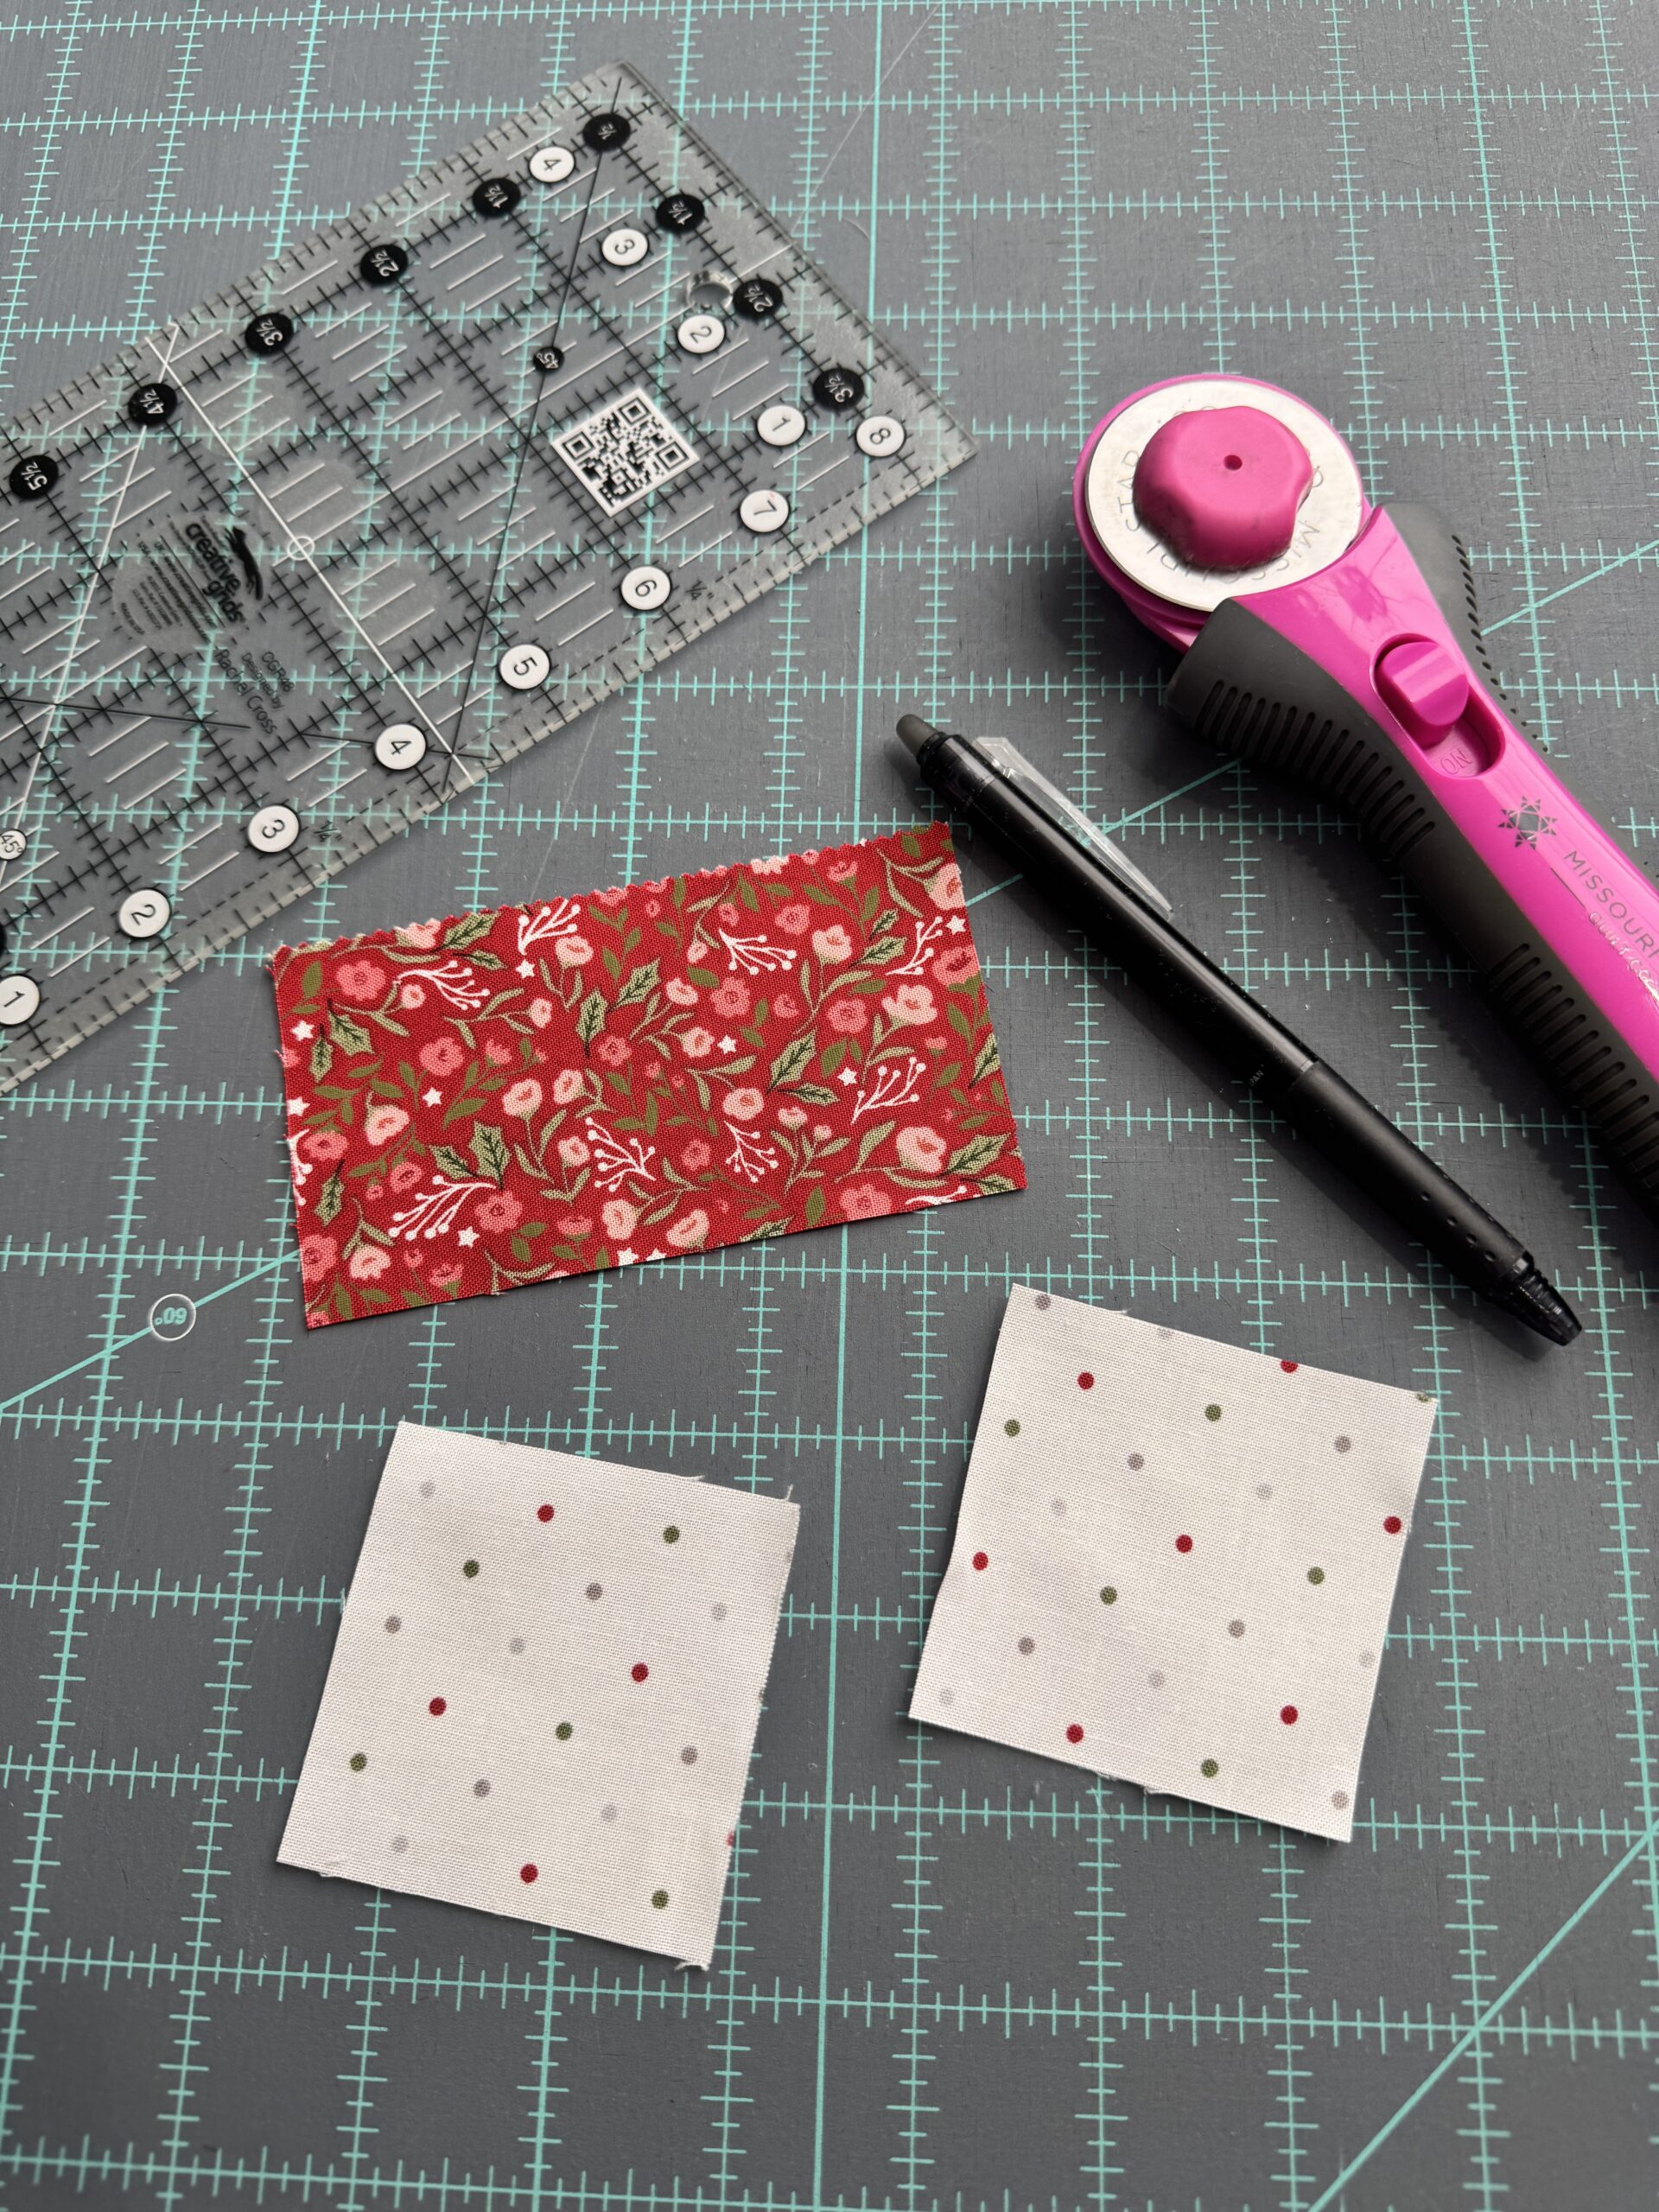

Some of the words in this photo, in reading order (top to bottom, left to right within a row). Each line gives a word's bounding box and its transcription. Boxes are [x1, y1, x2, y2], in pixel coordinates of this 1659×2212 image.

[543, 159, 562, 170] 4
[613, 238, 636, 255] 3
[689, 326, 713, 344] 2
[772, 416, 791, 432] 1
[869, 428, 892, 445] 8
[753, 499, 778, 516] 7
[187, 524, 240, 596] creative
[634, 579, 658, 597] 6
[513, 657, 537, 676] 5
[214, 649, 255, 696] Rachel
[247, 695, 277, 734] Cross
[391, 741, 412, 755] 4
[261, 818, 285, 839] 3
[1563, 850, 1659, 957] MISSOURI
[130, 904, 156, 925] 2
[3, 990, 25, 1007] 1
